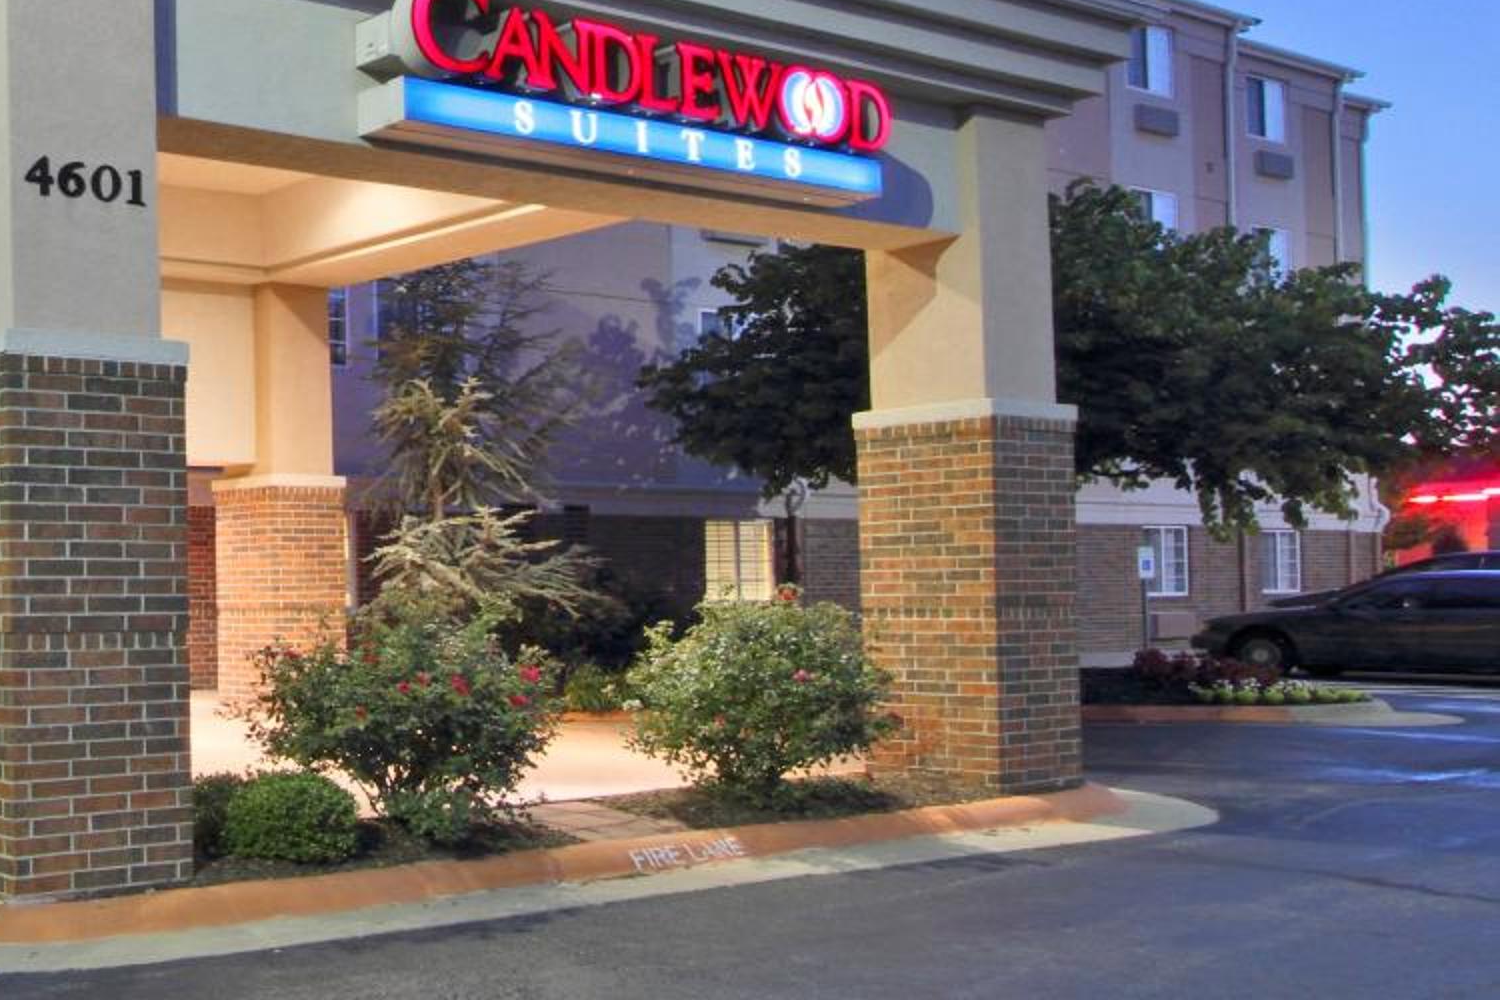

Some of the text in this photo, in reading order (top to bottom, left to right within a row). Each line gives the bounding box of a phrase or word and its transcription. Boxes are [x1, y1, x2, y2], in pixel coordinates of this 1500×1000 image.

[514, 100, 803, 179] SUITES
[24, 154, 147, 207] 4601
[629, 844, 679, 872] FIRE
